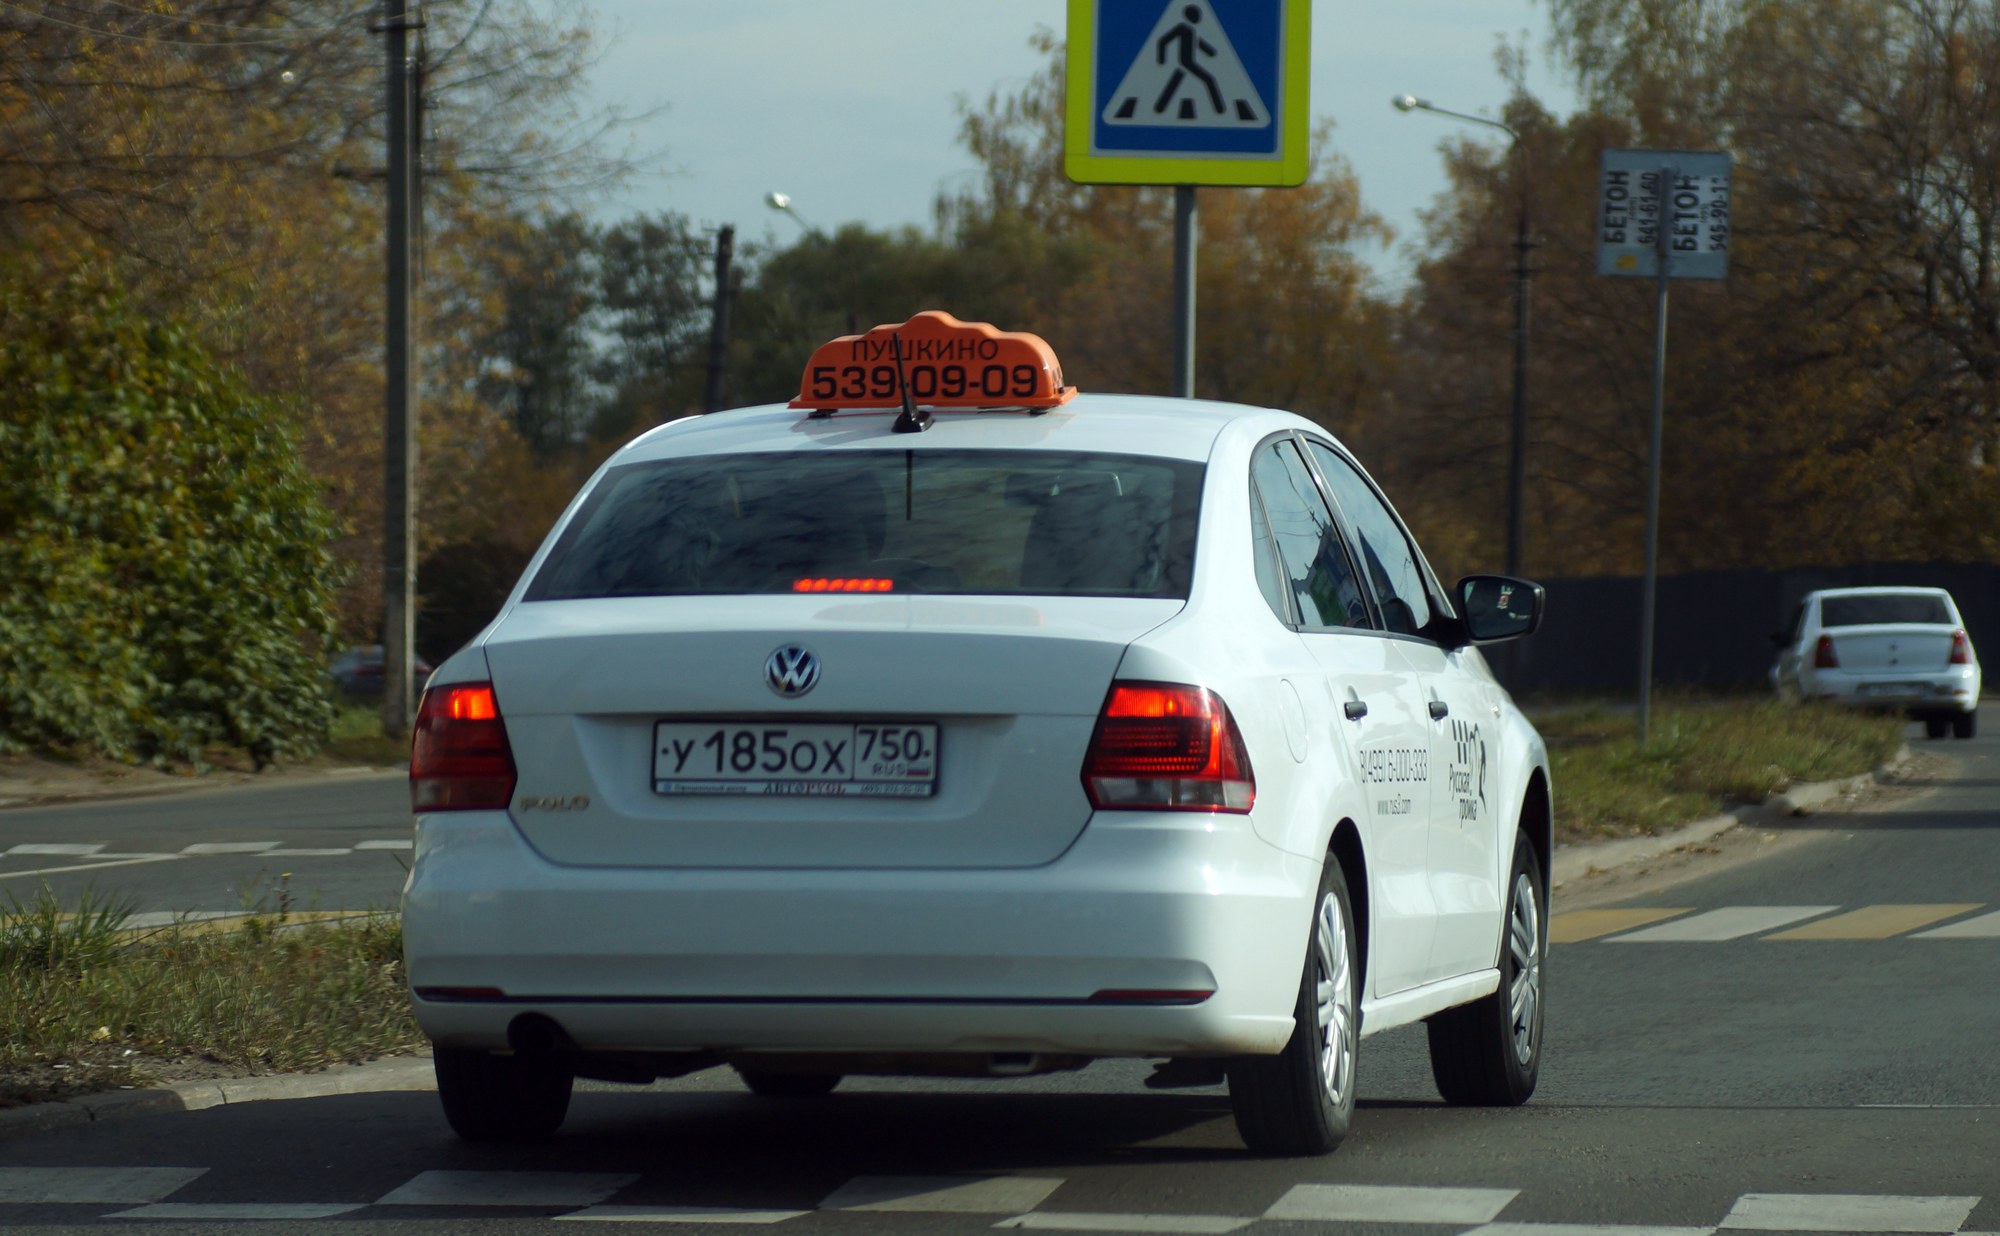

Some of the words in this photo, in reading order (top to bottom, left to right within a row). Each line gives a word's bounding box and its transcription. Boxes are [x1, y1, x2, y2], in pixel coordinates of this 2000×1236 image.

[1604, 170, 1629, 243] БЕТОН
[1672, 175, 1700, 251] БЕТОН
[852, 338, 999, 361] ПУШКИНО
[857, 728, 924, 762] 750
[872, 762, 907, 777] RUS
[520, 794, 590, 814] POLO
